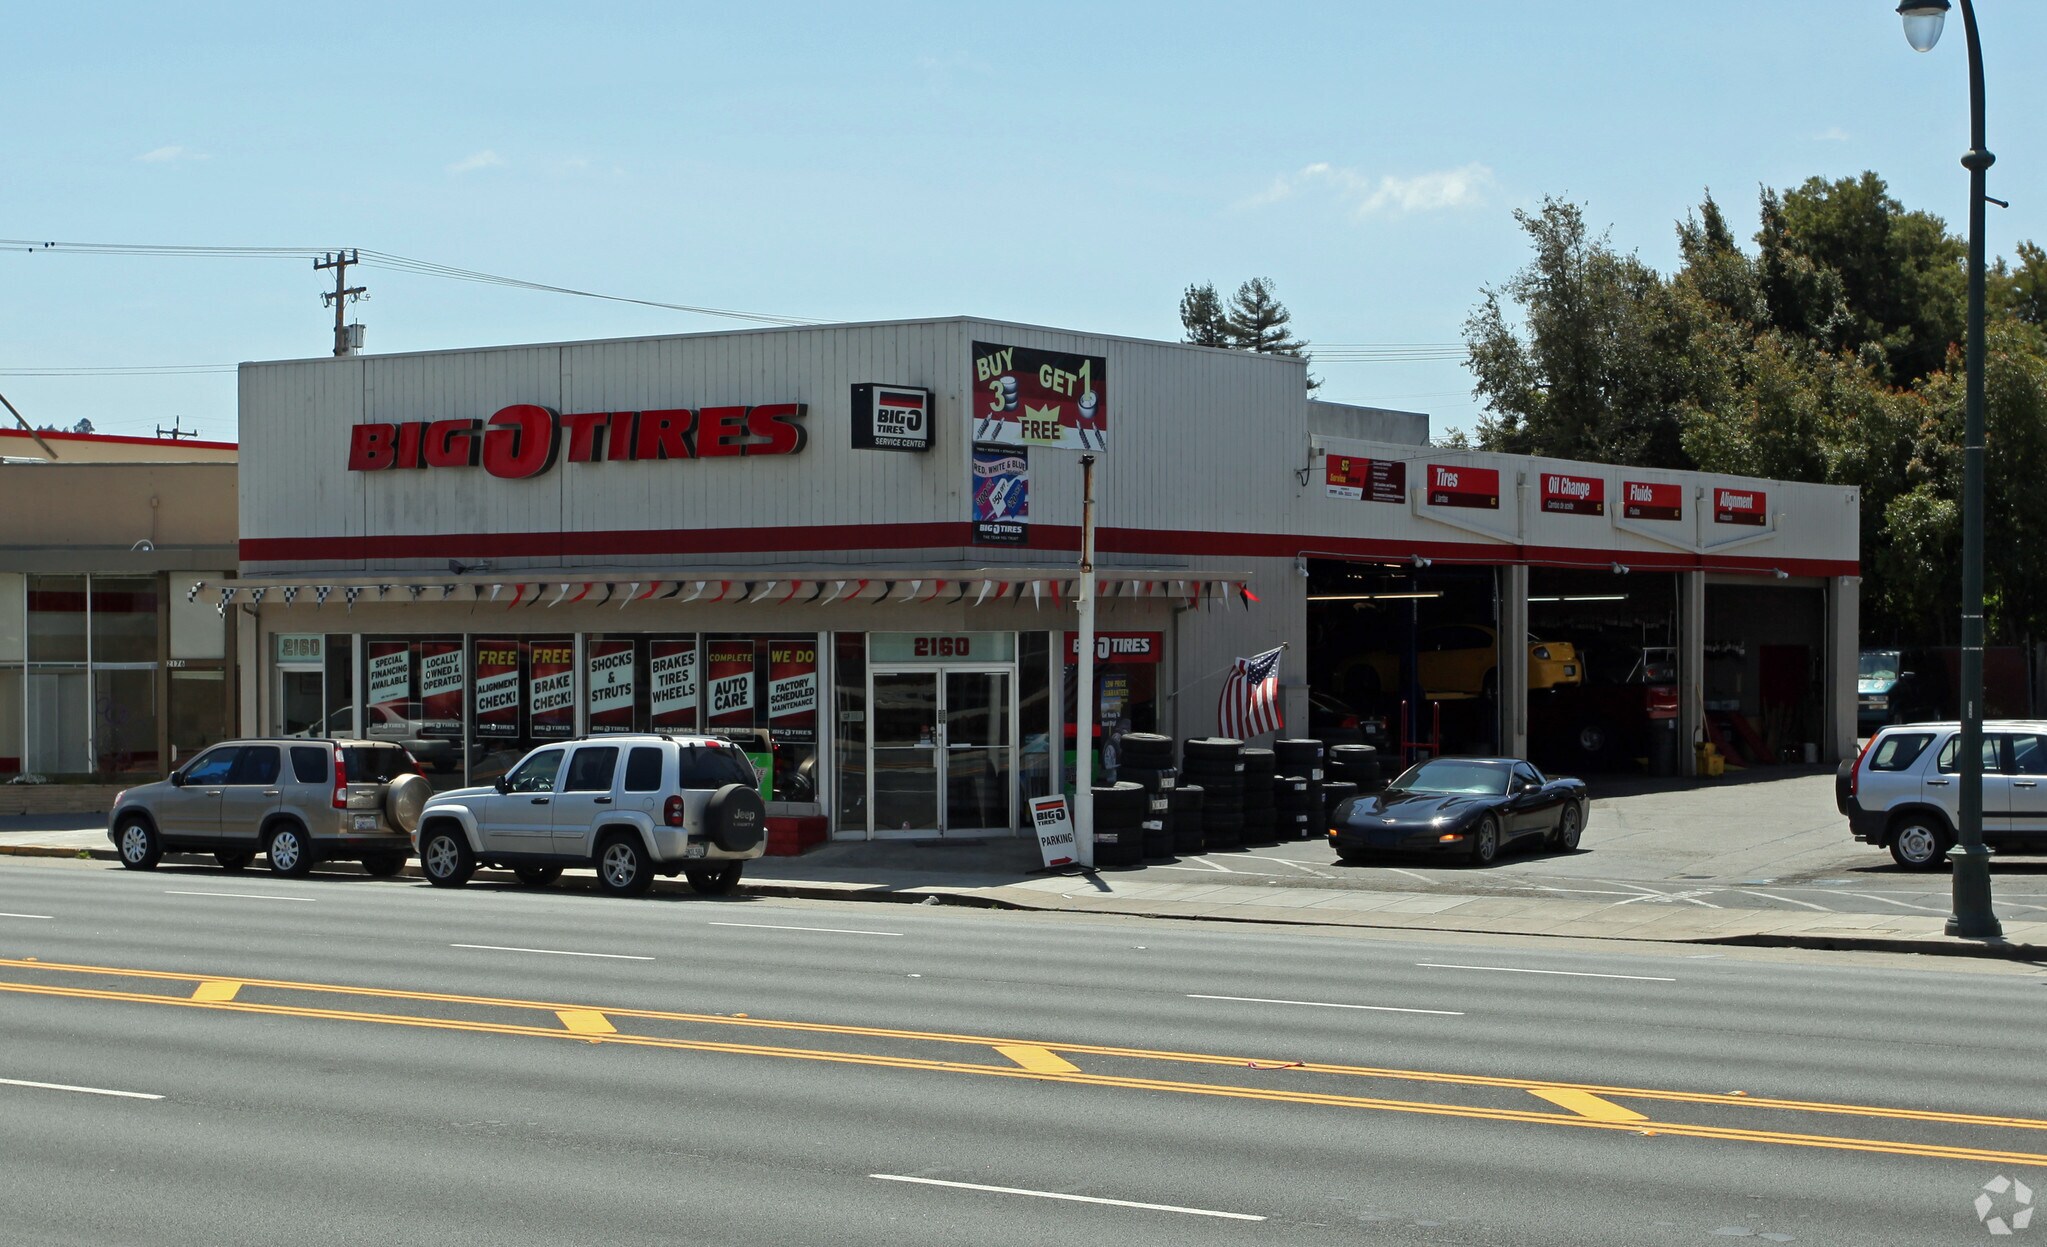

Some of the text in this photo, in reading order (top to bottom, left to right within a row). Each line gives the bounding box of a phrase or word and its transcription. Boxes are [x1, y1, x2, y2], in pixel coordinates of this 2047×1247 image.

[976, 347, 1014, 382] BUY
[1039, 359, 1091, 402] GET 1
[989, 380, 1006, 412] 3
[876, 424, 905, 434] TIRES
[877, 409, 922, 432] BIG O
[1021, 419, 1061, 440] FREE
[348, 403, 808, 479] BIG O TIRES
[875, 437, 926, 448] SERVICE CENTER
[988, 461, 1005, 474] WHITE
[1012, 459, 1026, 471] BLUE
[1436, 468, 1459, 488] Tires
[1548, 476, 1590, 500] Oil Change
[1630, 484, 1653, 502] Fluids
[1719, 491, 1753, 511] Alignment
[979, 524, 993, 532] BIG
[1001, 525, 1022, 534] TIRES
[914, 637, 970, 657] 2160
[1111, 638, 1151, 653] TIRES
[375, 653, 404, 669] SPECIAL
[426, 653, 459, 669] LOCALLY
[478, 650, 517, 666] FREE
[532, 649, 571, 664] FREE
[591, 652, 632, 673] SHOCKS
[652, 652, 695, 673] BRAKES
[709, 653, 753, 662] COMPLETE
[771, 650, 815, 663] WE DO
[371, 664, 408, 681] FINANCING
[425, 664, 460, 679] OWNED &
[607, 671, 615, 683] &
[658, 669, 689, 687] TIRES
[371, 674, 408, 691] AVAILABLE
[423, 674, 462, 691] OPERATED
[477, 677, 518, 695] ALIGNMENT
[534, 674, 570, 694] BRAKE
[714, 676, 748, 697] AUTO
[775, 677, 810, 693] FACTORY
[478, 691, 516, 710] CHECK!
[533, 690, 572, 711] CHECK!
[592, 682, 632, 702] STRUTS
[652, 683, 696, 703] WHEELS
[714, 691, 748, 711] CARE
[770, 686, 815, 704] SCHEDULED
[771, 698, 813, 713] MAINTENANCE
[734, 809, 755, 821] Jeep
[1036, 808, 1066, 821] BIG O
[1038, 819, 1056, 827] TIRES
[1041, 833, 1073, 847] PARKING
